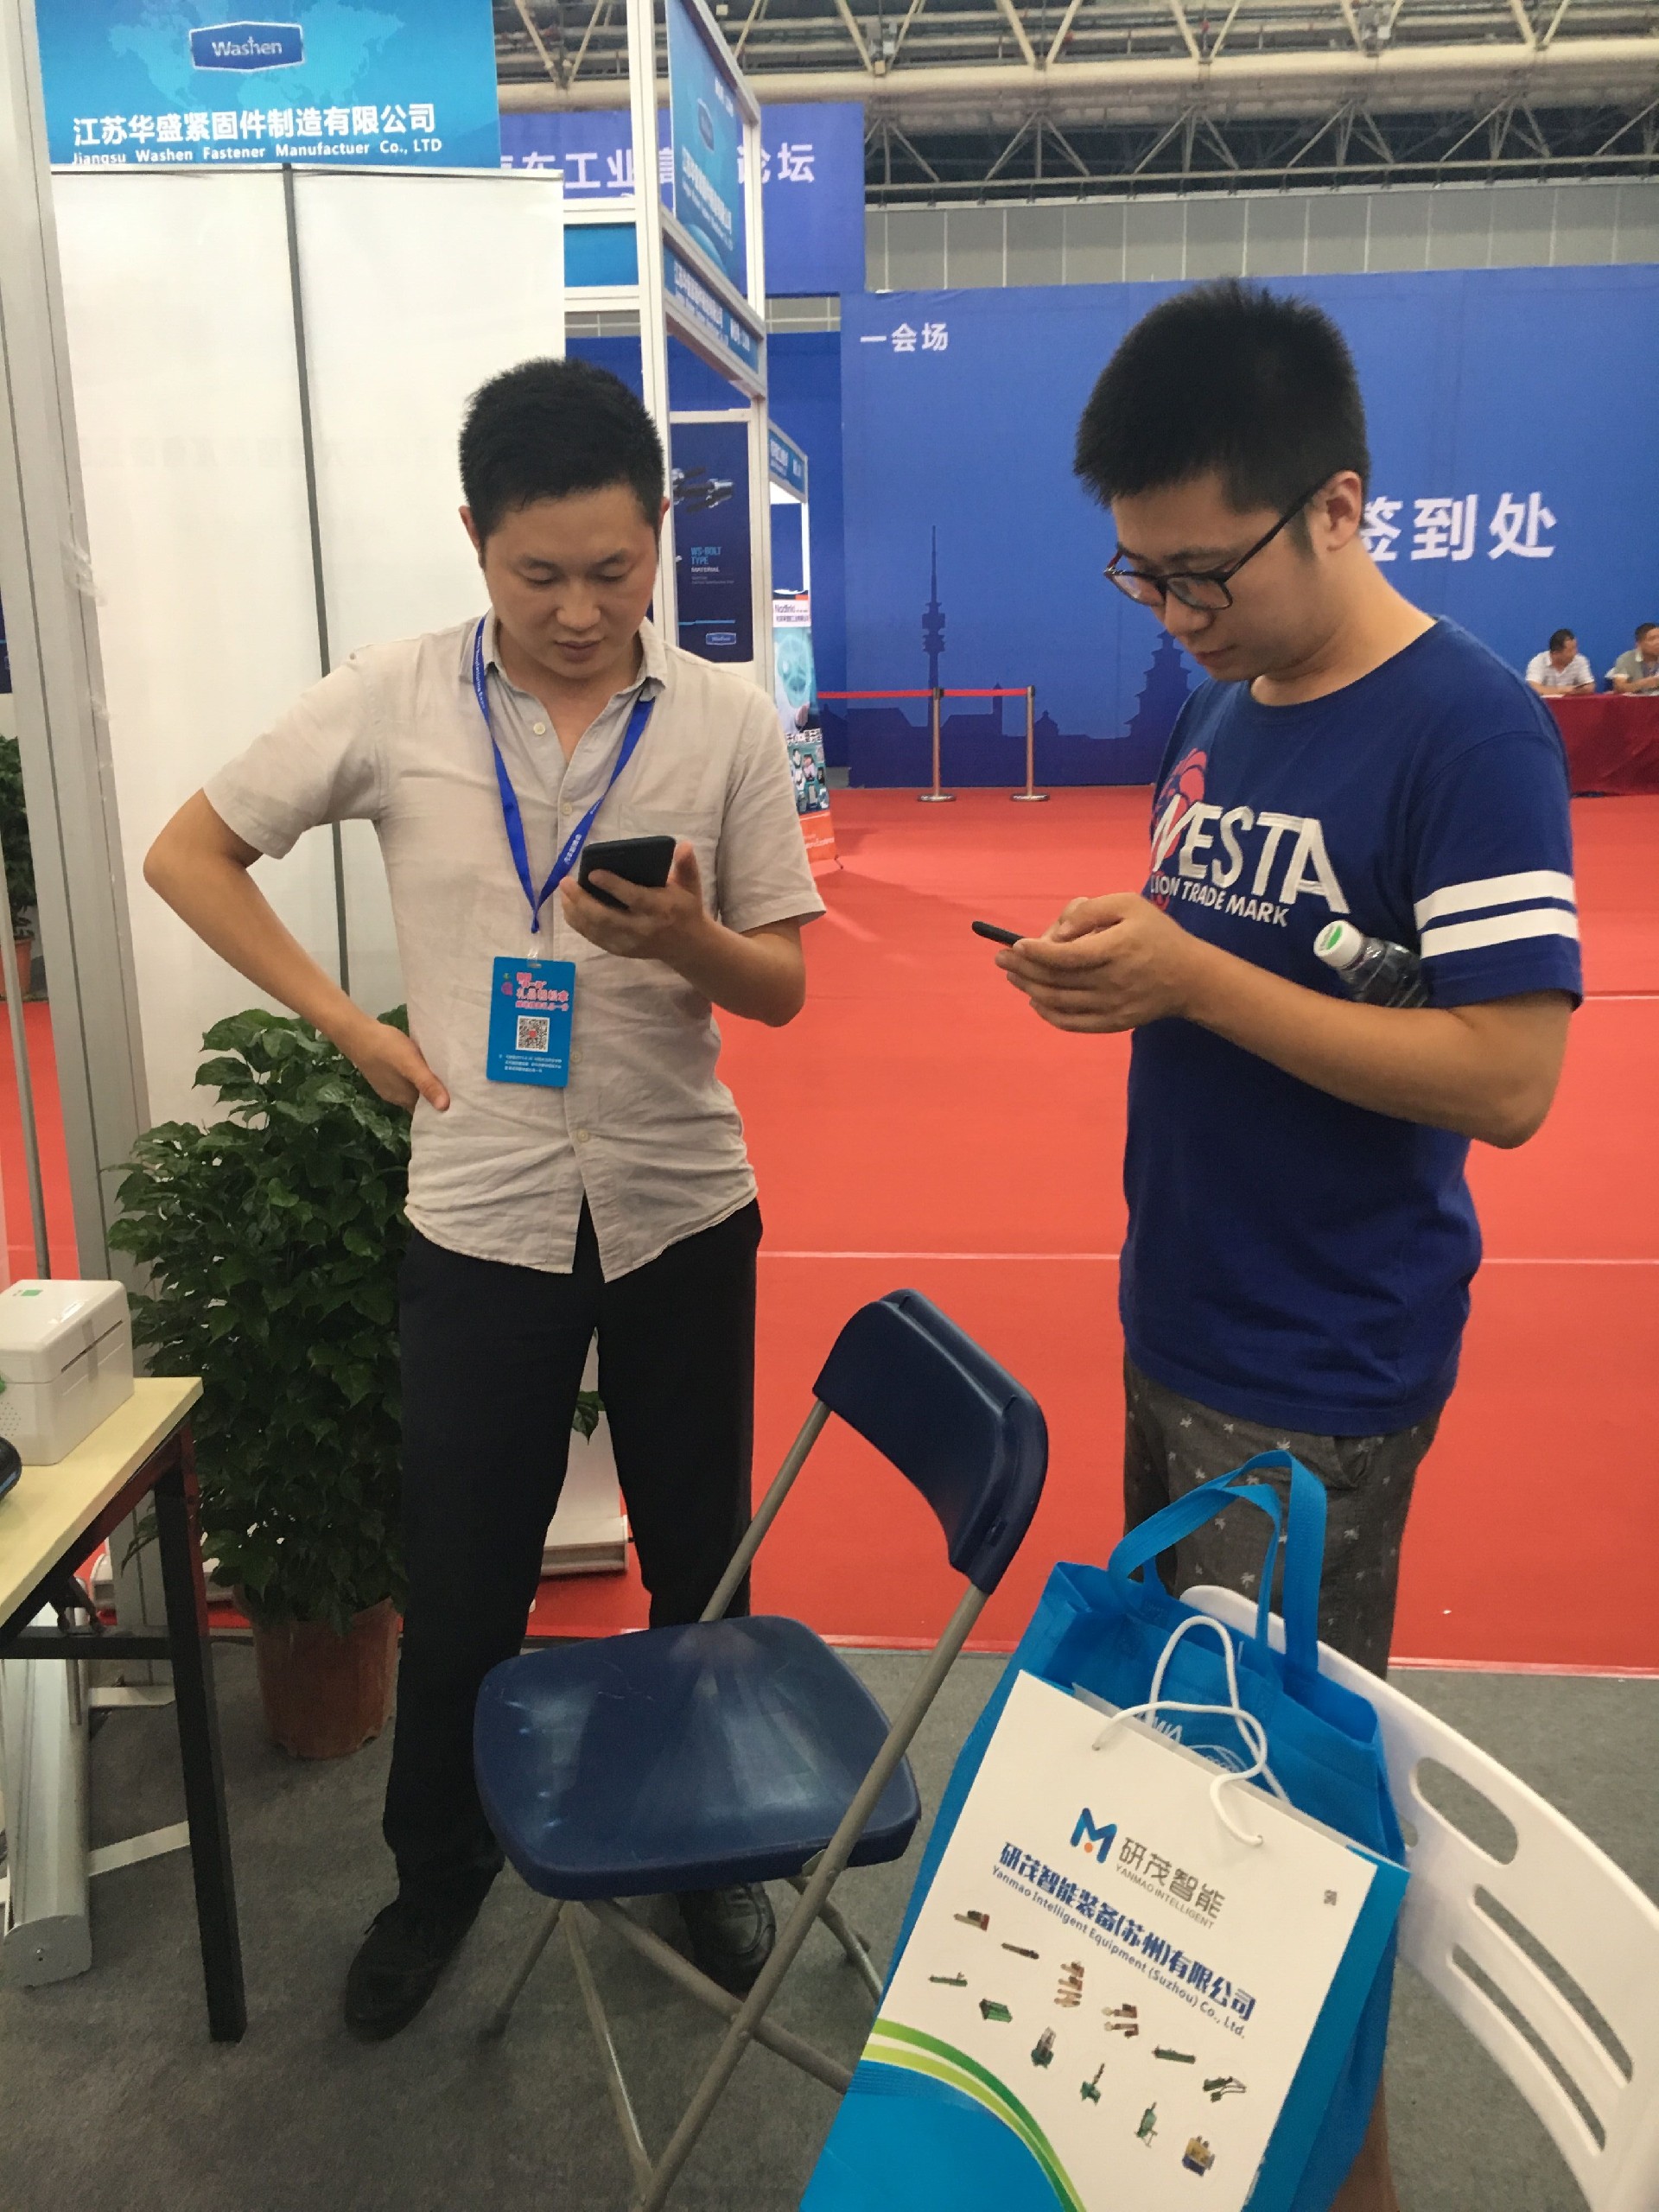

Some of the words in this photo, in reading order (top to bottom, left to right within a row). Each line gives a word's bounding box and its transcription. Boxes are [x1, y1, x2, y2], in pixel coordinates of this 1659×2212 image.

[212, 36, 283, 56] Washen
[72, 151, 127, 165] Jiangsu
[135, 149, 193, 162] Washen
[203, 146, 265, 160] Fastener
[276, 142, 370, 157] Manufactuer
[379, 140, 408, 156] Co.,
[414, 138, 442, 153] LTD
[73, 103, 435, 147] 江苏华盛紧固件制造有限公司
[860, 322, 949, 353] 一会场
[1360, 492, 1557, 562] 签到处
[1181, 880, 1226, 911] TRADE
[1224, 893, 1290, 927] MARK
[1116, 1864, 1155, 1892] YANMAO
[1154, 1889, 1215, 1929] INTELLIGENT
[1119, 1837, 1225, 1918] 研茂智能
[992, 1866, 1032, 1897] Yanmao
[1032, 1891, 1089, 1934] Intelligent
[1088, 1928, 1147, 1974] Equipment
[1147, 1967, 1199, 2008] (Suzhou)
[1198, 1999, 1221, 2025] Co.,
[1223, 2016, 1245, 2039] Ltd.
[999, 1841, 1256, 2021] 研茂智能装备(苏州)有限公司
